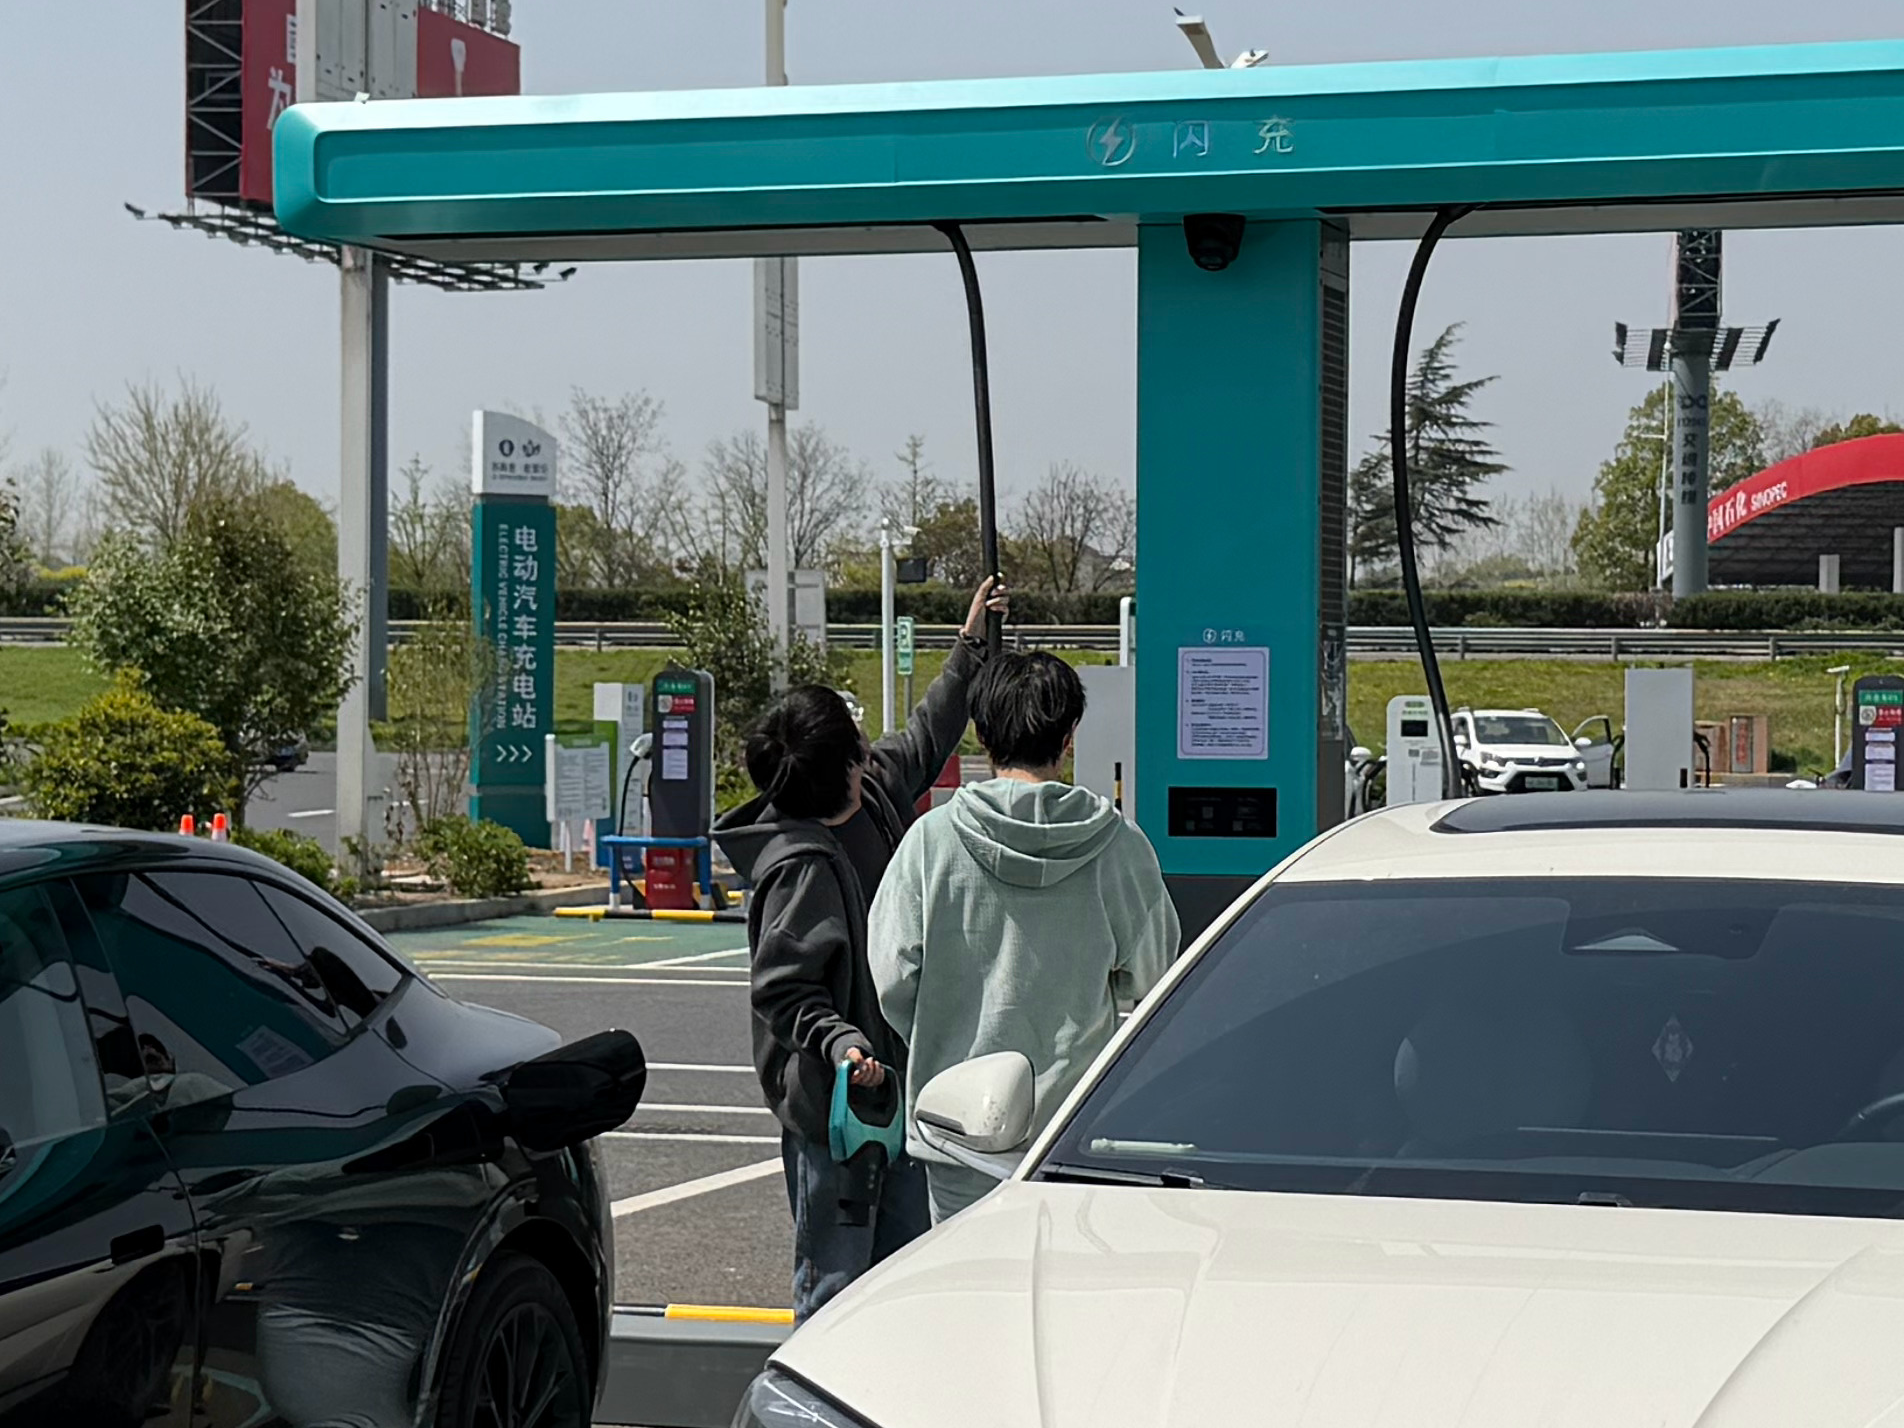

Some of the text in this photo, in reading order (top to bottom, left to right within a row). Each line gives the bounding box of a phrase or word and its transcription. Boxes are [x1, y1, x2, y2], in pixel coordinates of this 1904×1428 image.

[1172, 115, 1294, 159] 闪充
[1751, 480, 1788, 512] SINOPEC
[498, 524, 509, 579] ELECTRIC
[497, 581, 508, 630] VEHICLE
[512, 525, 538, 729] 电动汽车充电站
